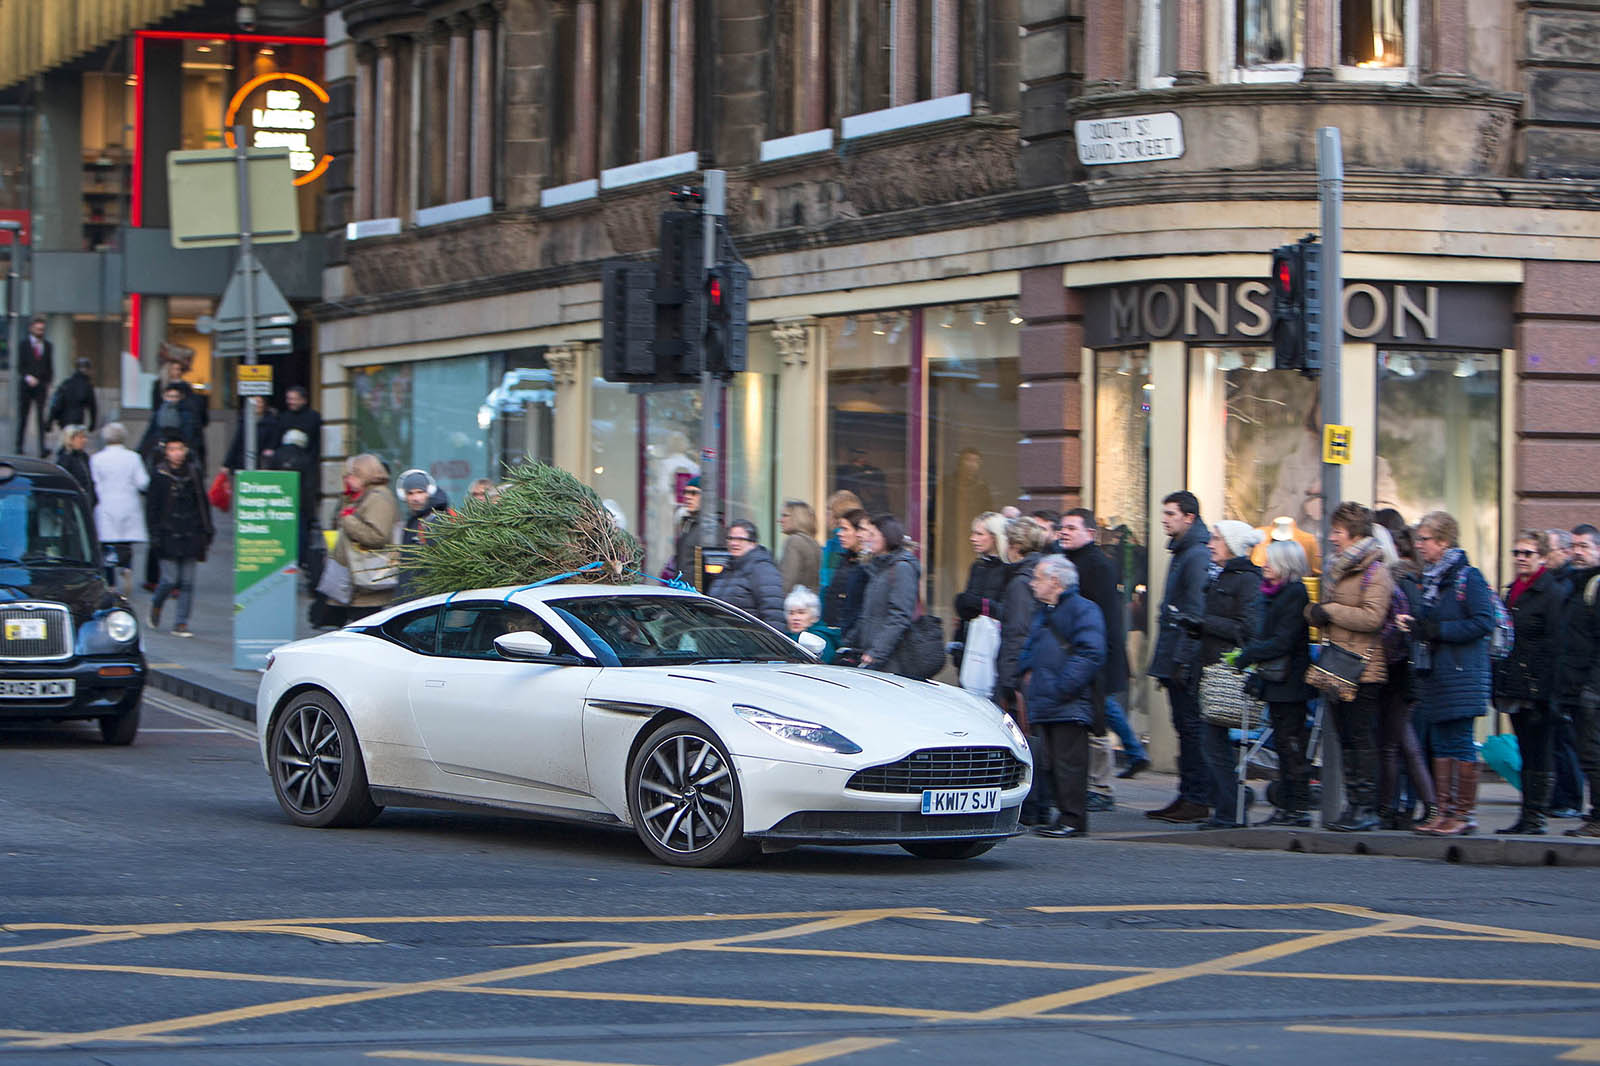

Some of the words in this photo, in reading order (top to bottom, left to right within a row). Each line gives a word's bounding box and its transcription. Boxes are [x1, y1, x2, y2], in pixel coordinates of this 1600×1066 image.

[1088, 121, 1132, 139] SOUTH
[1080, 142, 1116, 159] DAVID
[1119, 137, 1173, 158] STREET
[1109, 281, 1439, 339] MONSON
[935, 792, 968, 811] KW17
[972, 791, 997, 809] SJV
